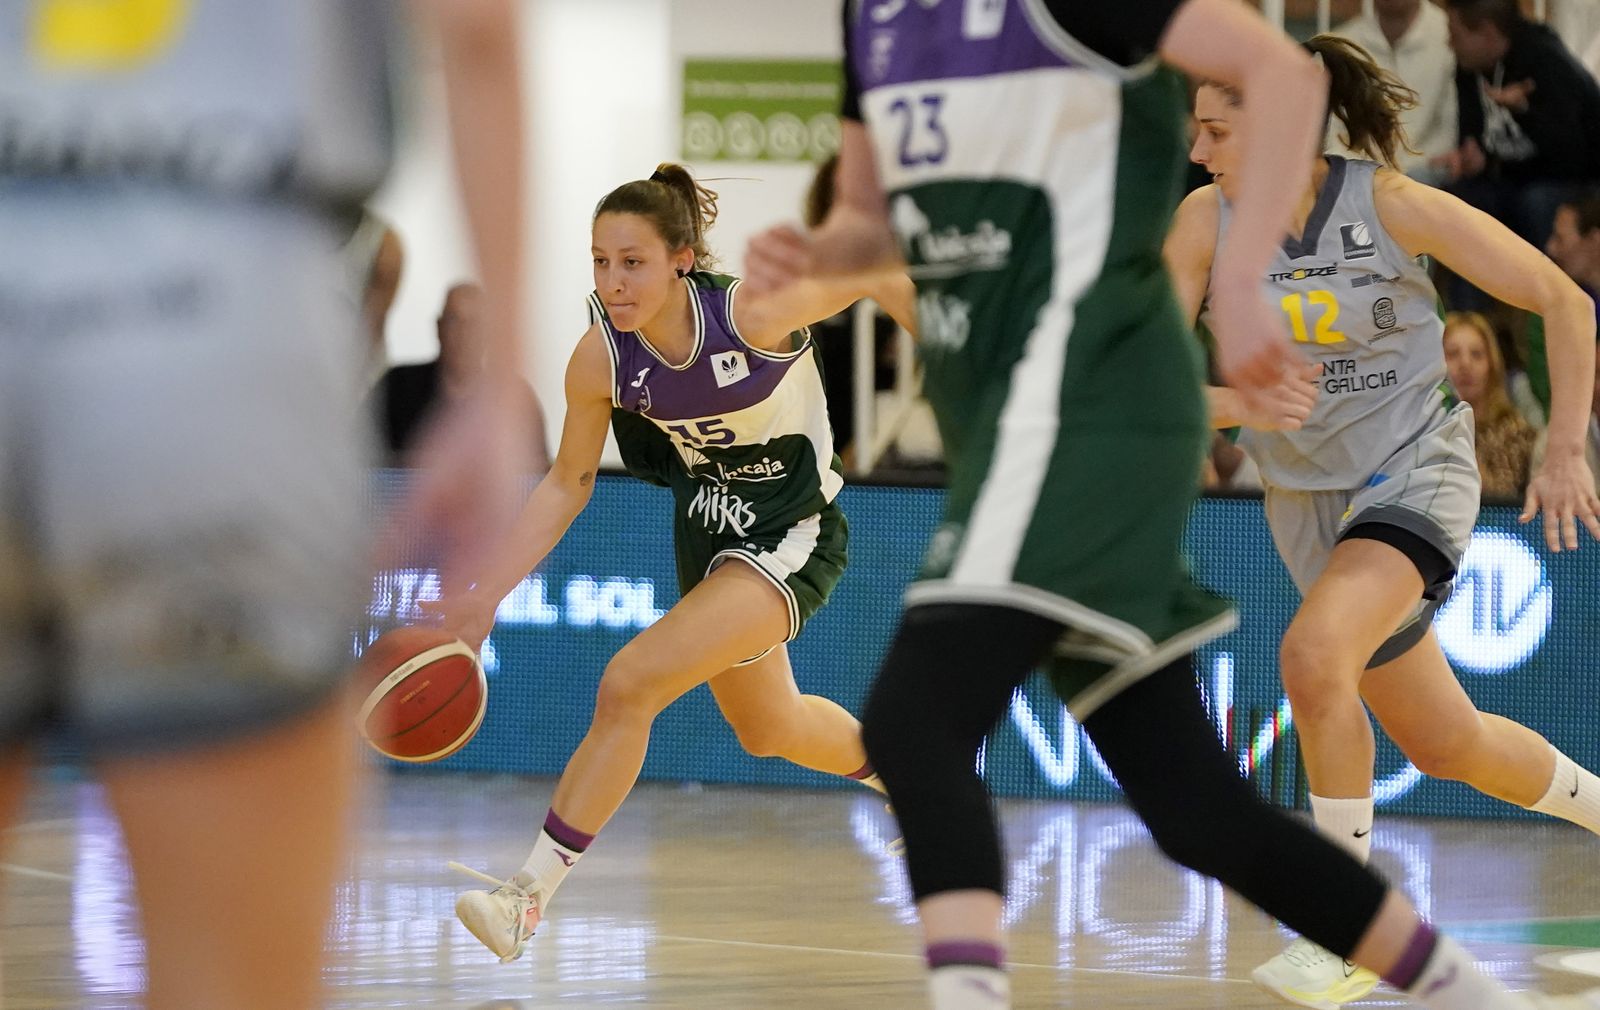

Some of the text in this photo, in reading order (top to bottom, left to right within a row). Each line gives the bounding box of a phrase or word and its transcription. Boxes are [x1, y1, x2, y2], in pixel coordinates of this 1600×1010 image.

[888, 94, 950, 168] 23
[1268, 266, 1338, 282] TROZZE
[1280, 289, 1346, 345] 12
[1322, 359, 1356, 377] NTA
[1325, 369, 1398, 394] GALICIA
[666, 418, 736, 446] 15
[687, 483, 757, 538] Mijas
